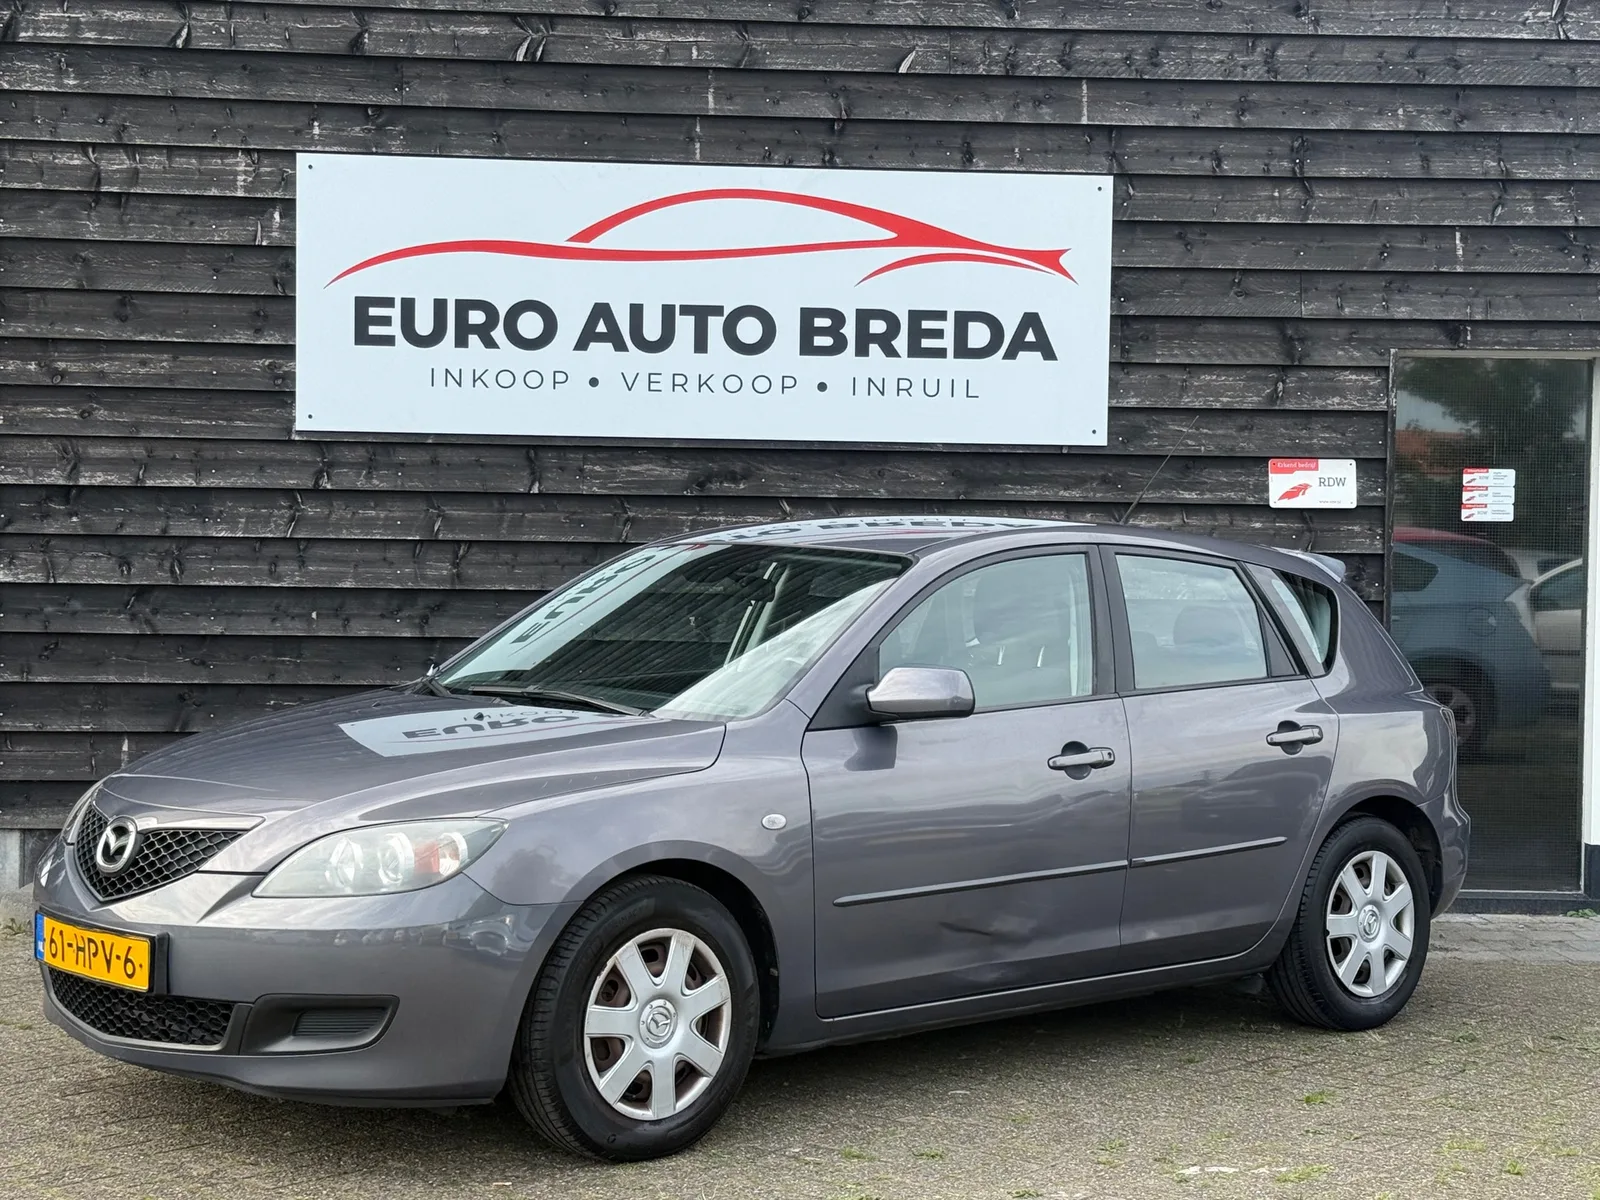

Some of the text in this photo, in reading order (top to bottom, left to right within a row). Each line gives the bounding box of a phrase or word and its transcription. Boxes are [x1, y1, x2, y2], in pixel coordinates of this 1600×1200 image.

[354, 295, 1058, 361] EURO AUTO BREDA
[431, 367, 980, 399] INKOOP VERKOOP INRUIL
[1318, 477, 1347, 487] RDW
[49, 926, 137, 980] 61-HPV-6
